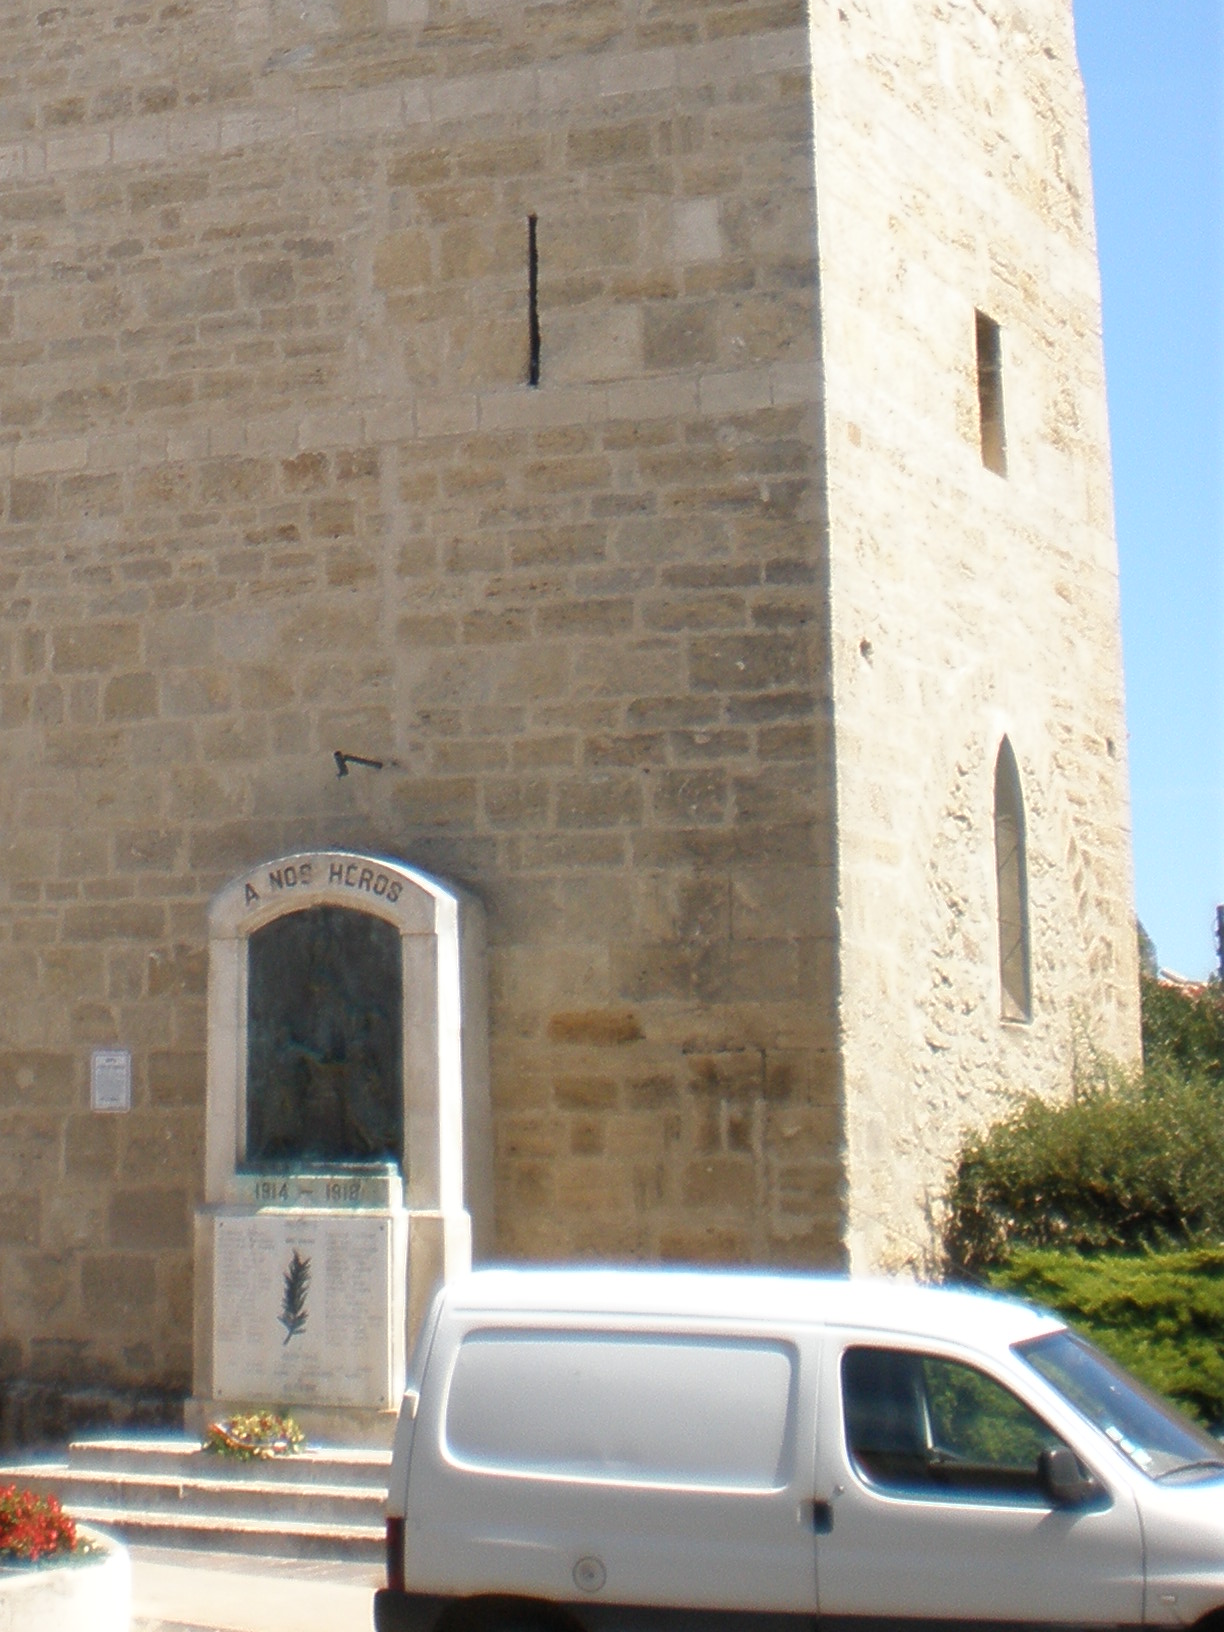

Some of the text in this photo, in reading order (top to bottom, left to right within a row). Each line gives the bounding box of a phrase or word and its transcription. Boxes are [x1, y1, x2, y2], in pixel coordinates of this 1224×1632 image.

[244, 882, 259, 906] A
[269, 863, 312, 892] NOS
[255, 1182, 288, 1201] 1914
[325, 1180, 362, 1201] 1918
